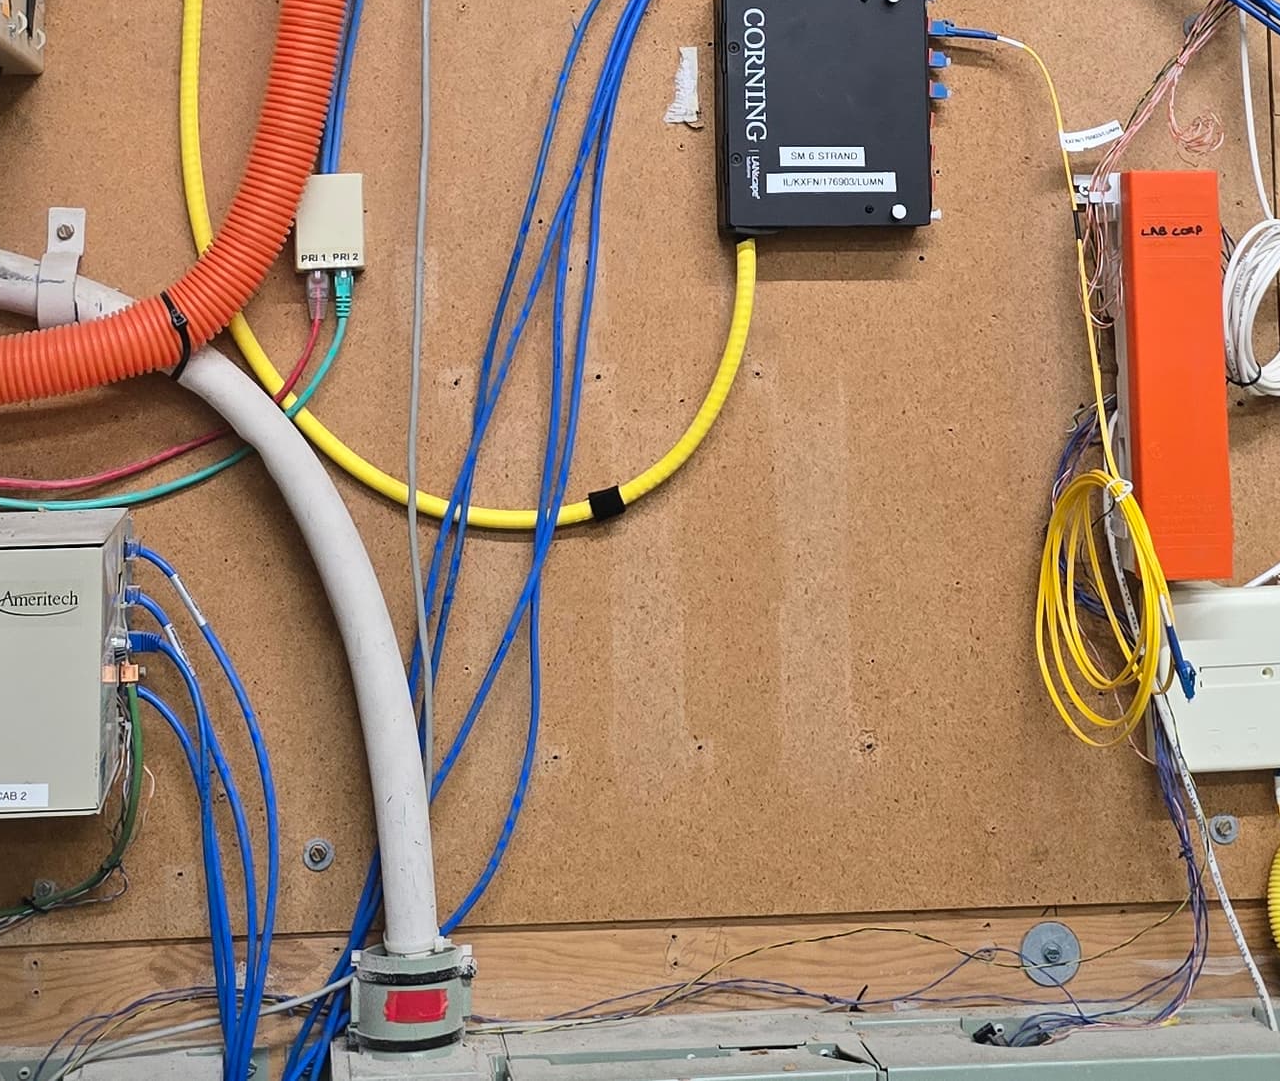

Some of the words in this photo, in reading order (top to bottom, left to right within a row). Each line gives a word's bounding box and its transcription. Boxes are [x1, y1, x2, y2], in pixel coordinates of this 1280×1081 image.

[743, 8, 768, 143] CORNING
[790, 152, 806, 161] SM
[808, 152, 815, 161] 6
[817, 152, 858, 161] STRAND
[1141, 226, 1168, 236] LAB
[1171, 225, 1203, 236] CORP
[301, 254, 318, 262] PRI
[332, 253, 349, 261] PRI
[353, 253, 359, 261] 2
[0, 590, 79, 607] Ameritech
[19, 791, 27, 801] 2
